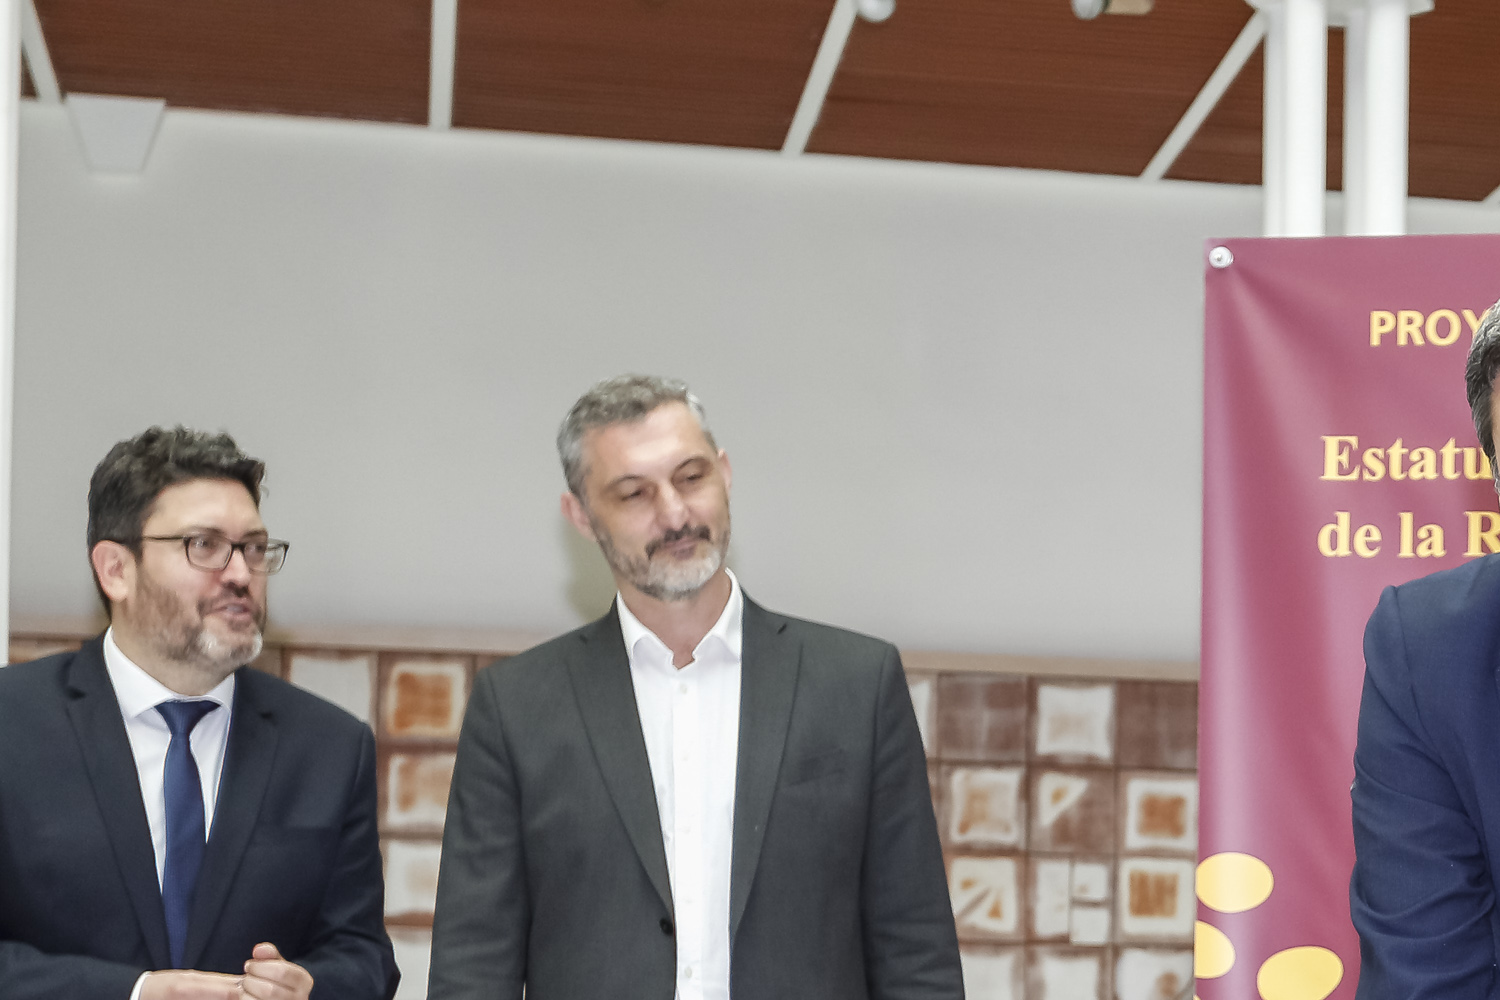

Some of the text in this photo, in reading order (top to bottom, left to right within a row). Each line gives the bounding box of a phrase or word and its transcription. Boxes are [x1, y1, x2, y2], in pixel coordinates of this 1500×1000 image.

[1368, 308, 1493, 348] PROY
[1319, 434, 1495, 482] Estatu
[1317, 510, 1383, 559] de
[1397, 510, 1447, 559] la
